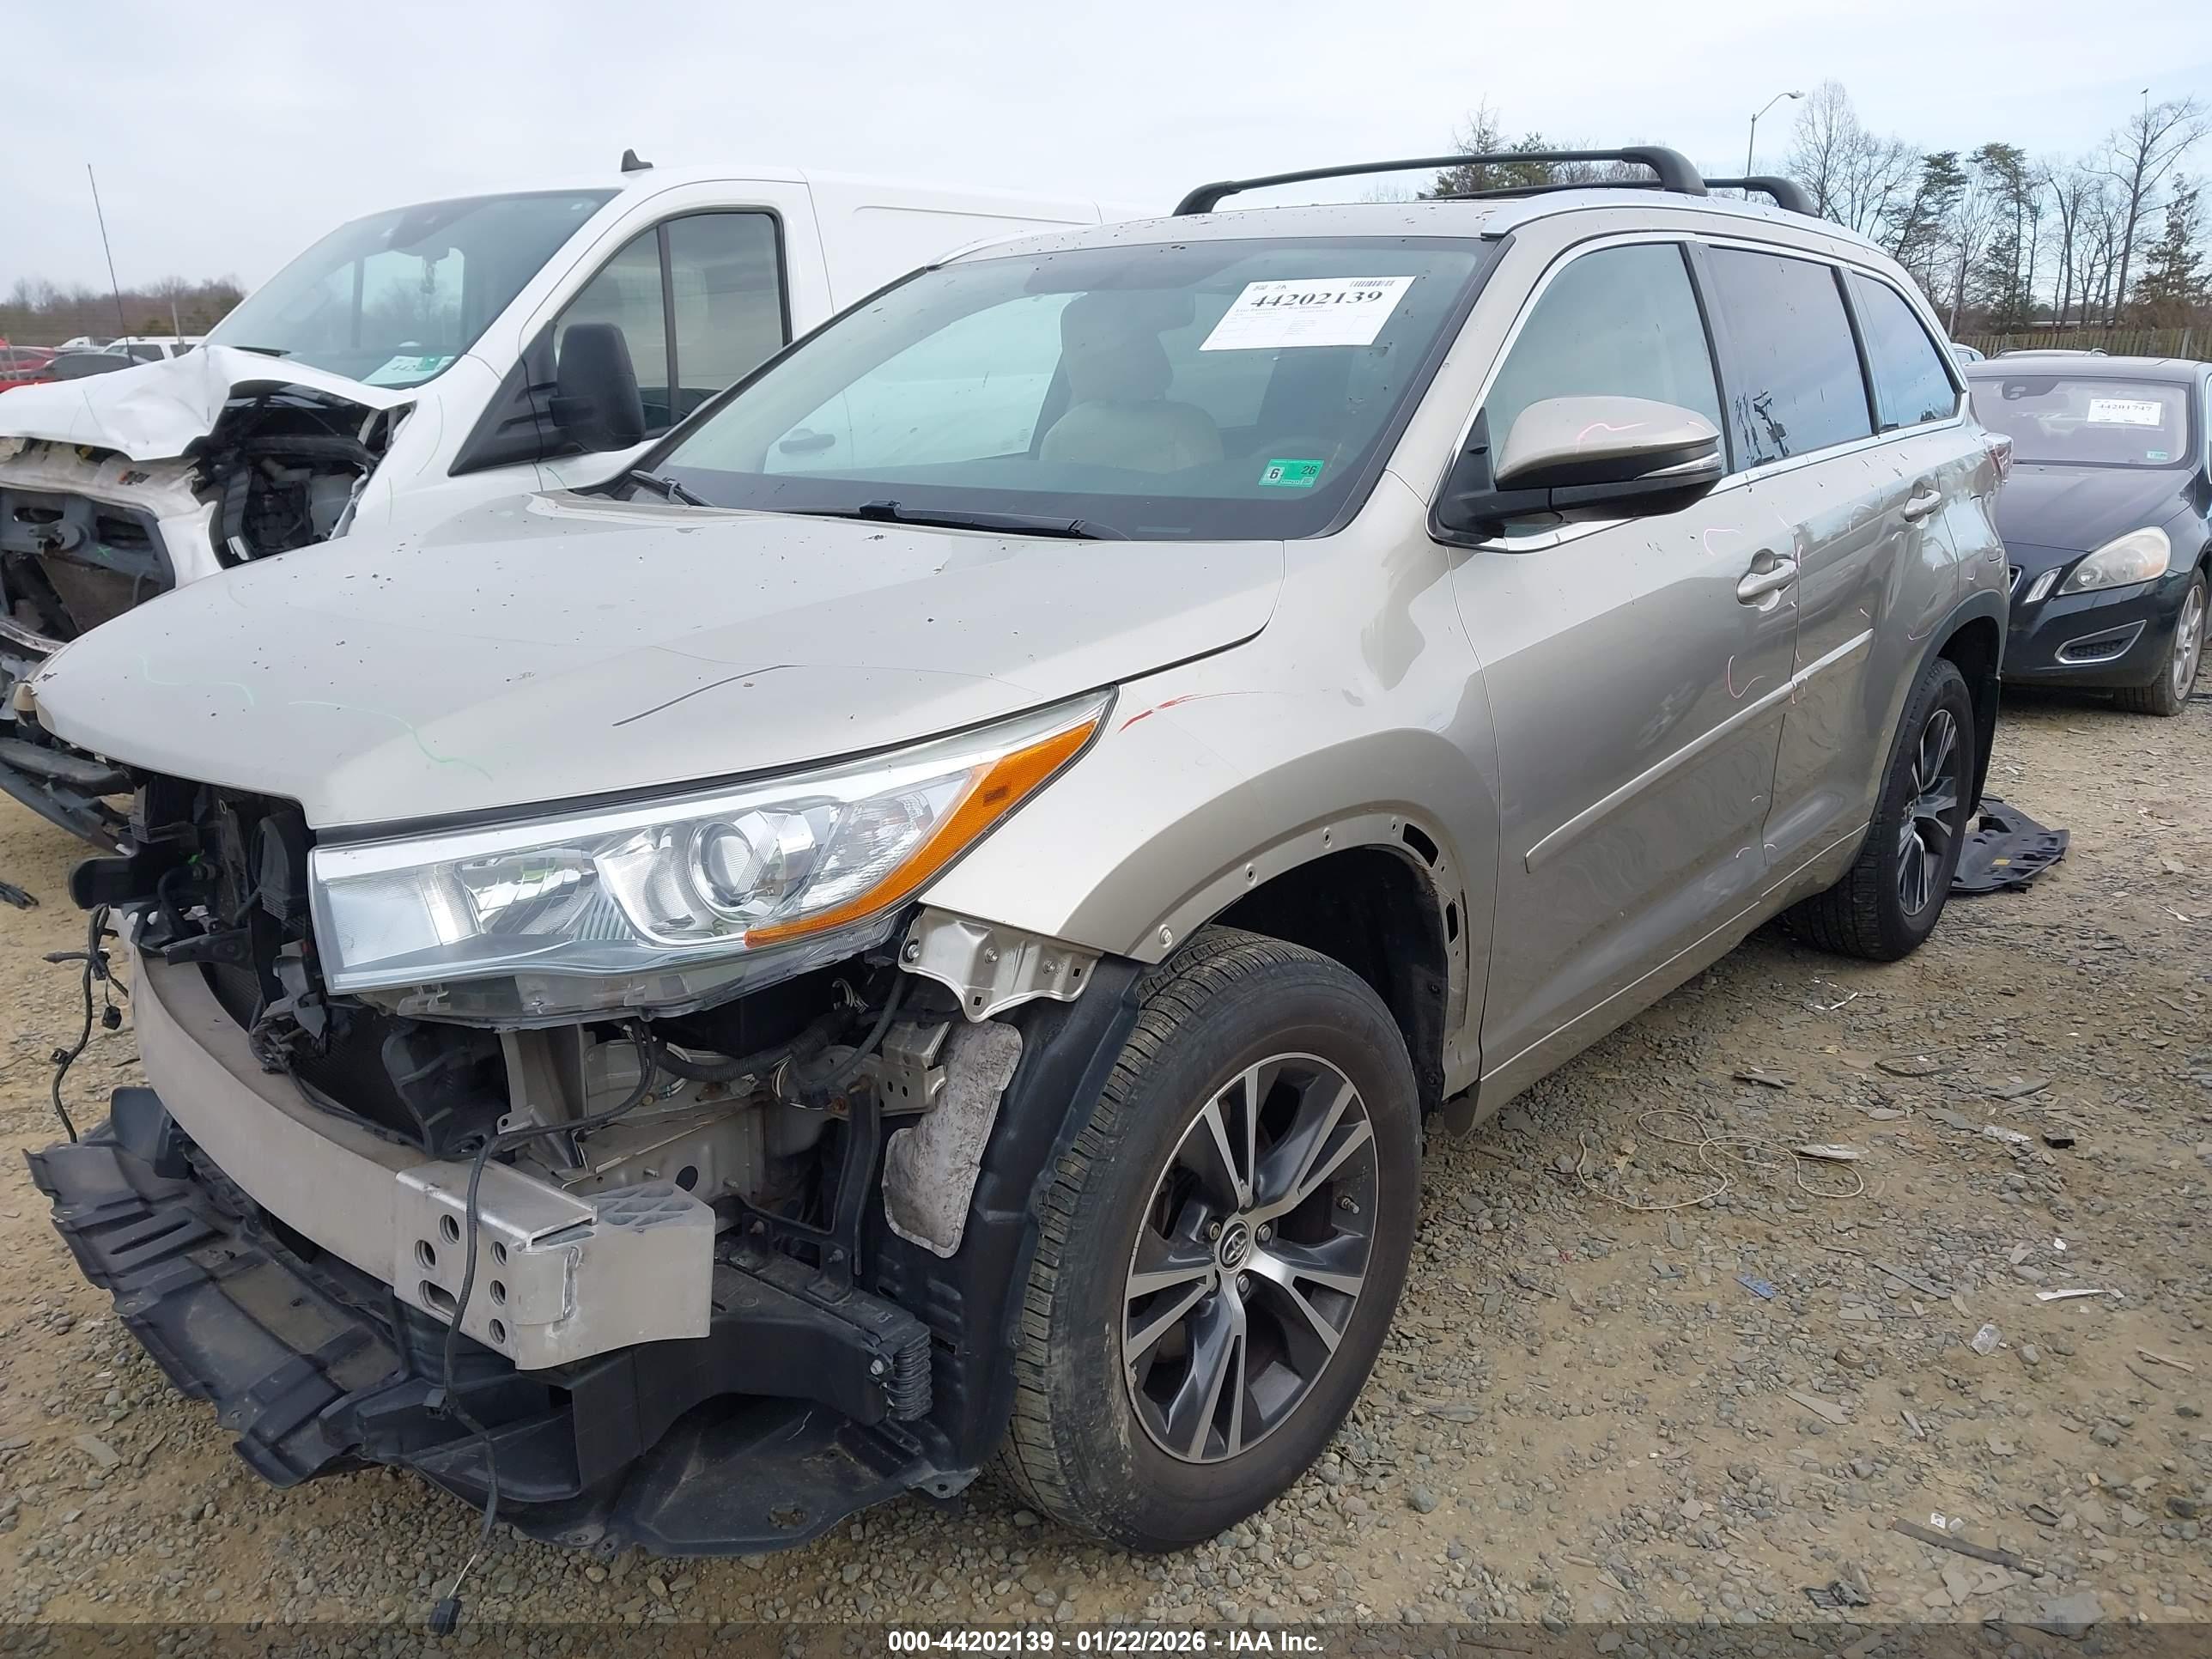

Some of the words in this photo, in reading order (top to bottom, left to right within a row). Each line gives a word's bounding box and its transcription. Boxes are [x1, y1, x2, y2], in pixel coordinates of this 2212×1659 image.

[1250, 290, 1383, 307] 44202139
[1269, 468, 1280, 479] 6
[1300, 465, 1318, 475] 26
